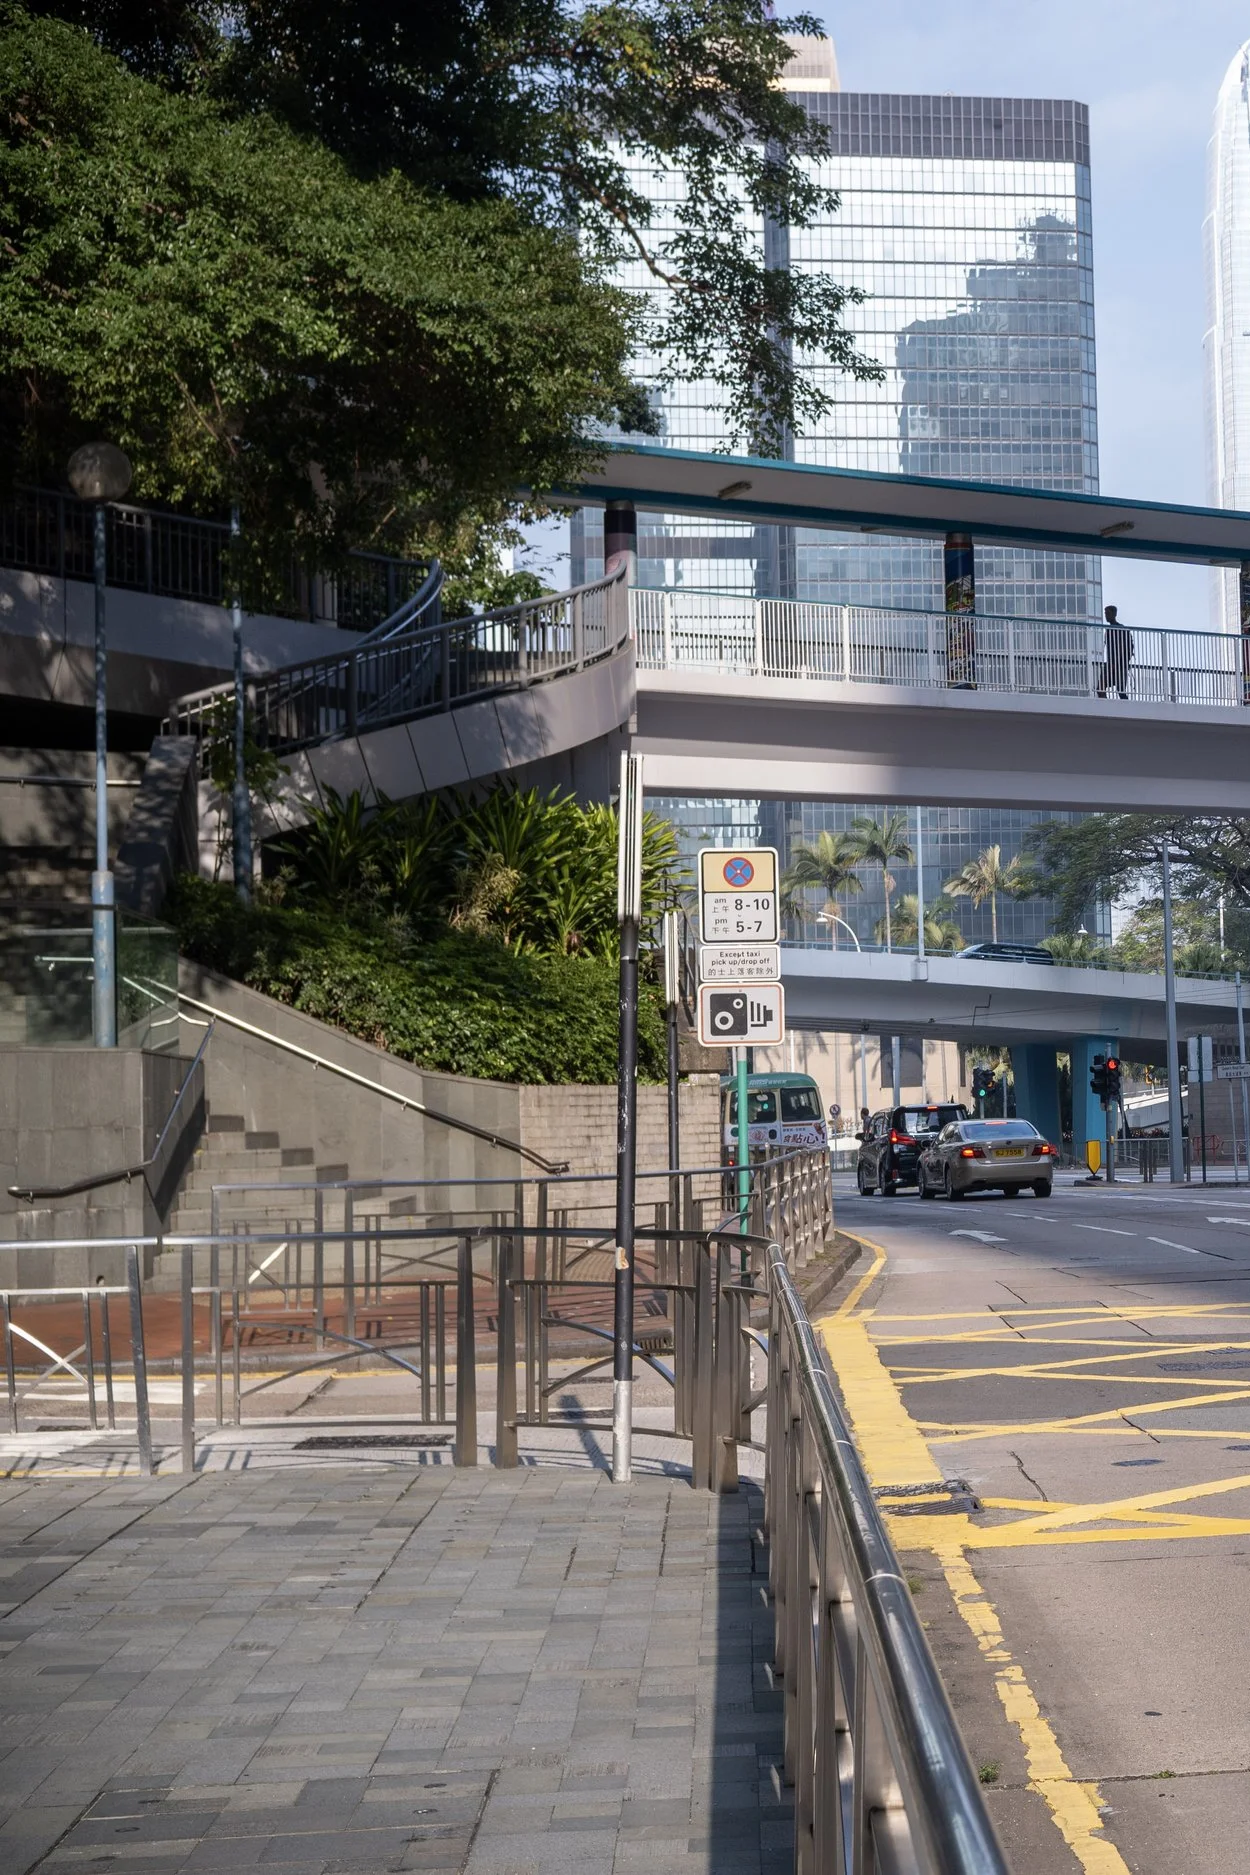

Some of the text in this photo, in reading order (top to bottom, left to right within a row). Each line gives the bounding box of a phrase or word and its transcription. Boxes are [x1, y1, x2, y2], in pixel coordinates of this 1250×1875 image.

[712, 905, 729, 914] 上午
[714, 918, 728, 926] pm
[712, 926, 730, 935] 下午
[719, 951, 745, 959] Except
[711, 957, 770, 966] pick up/drop off
